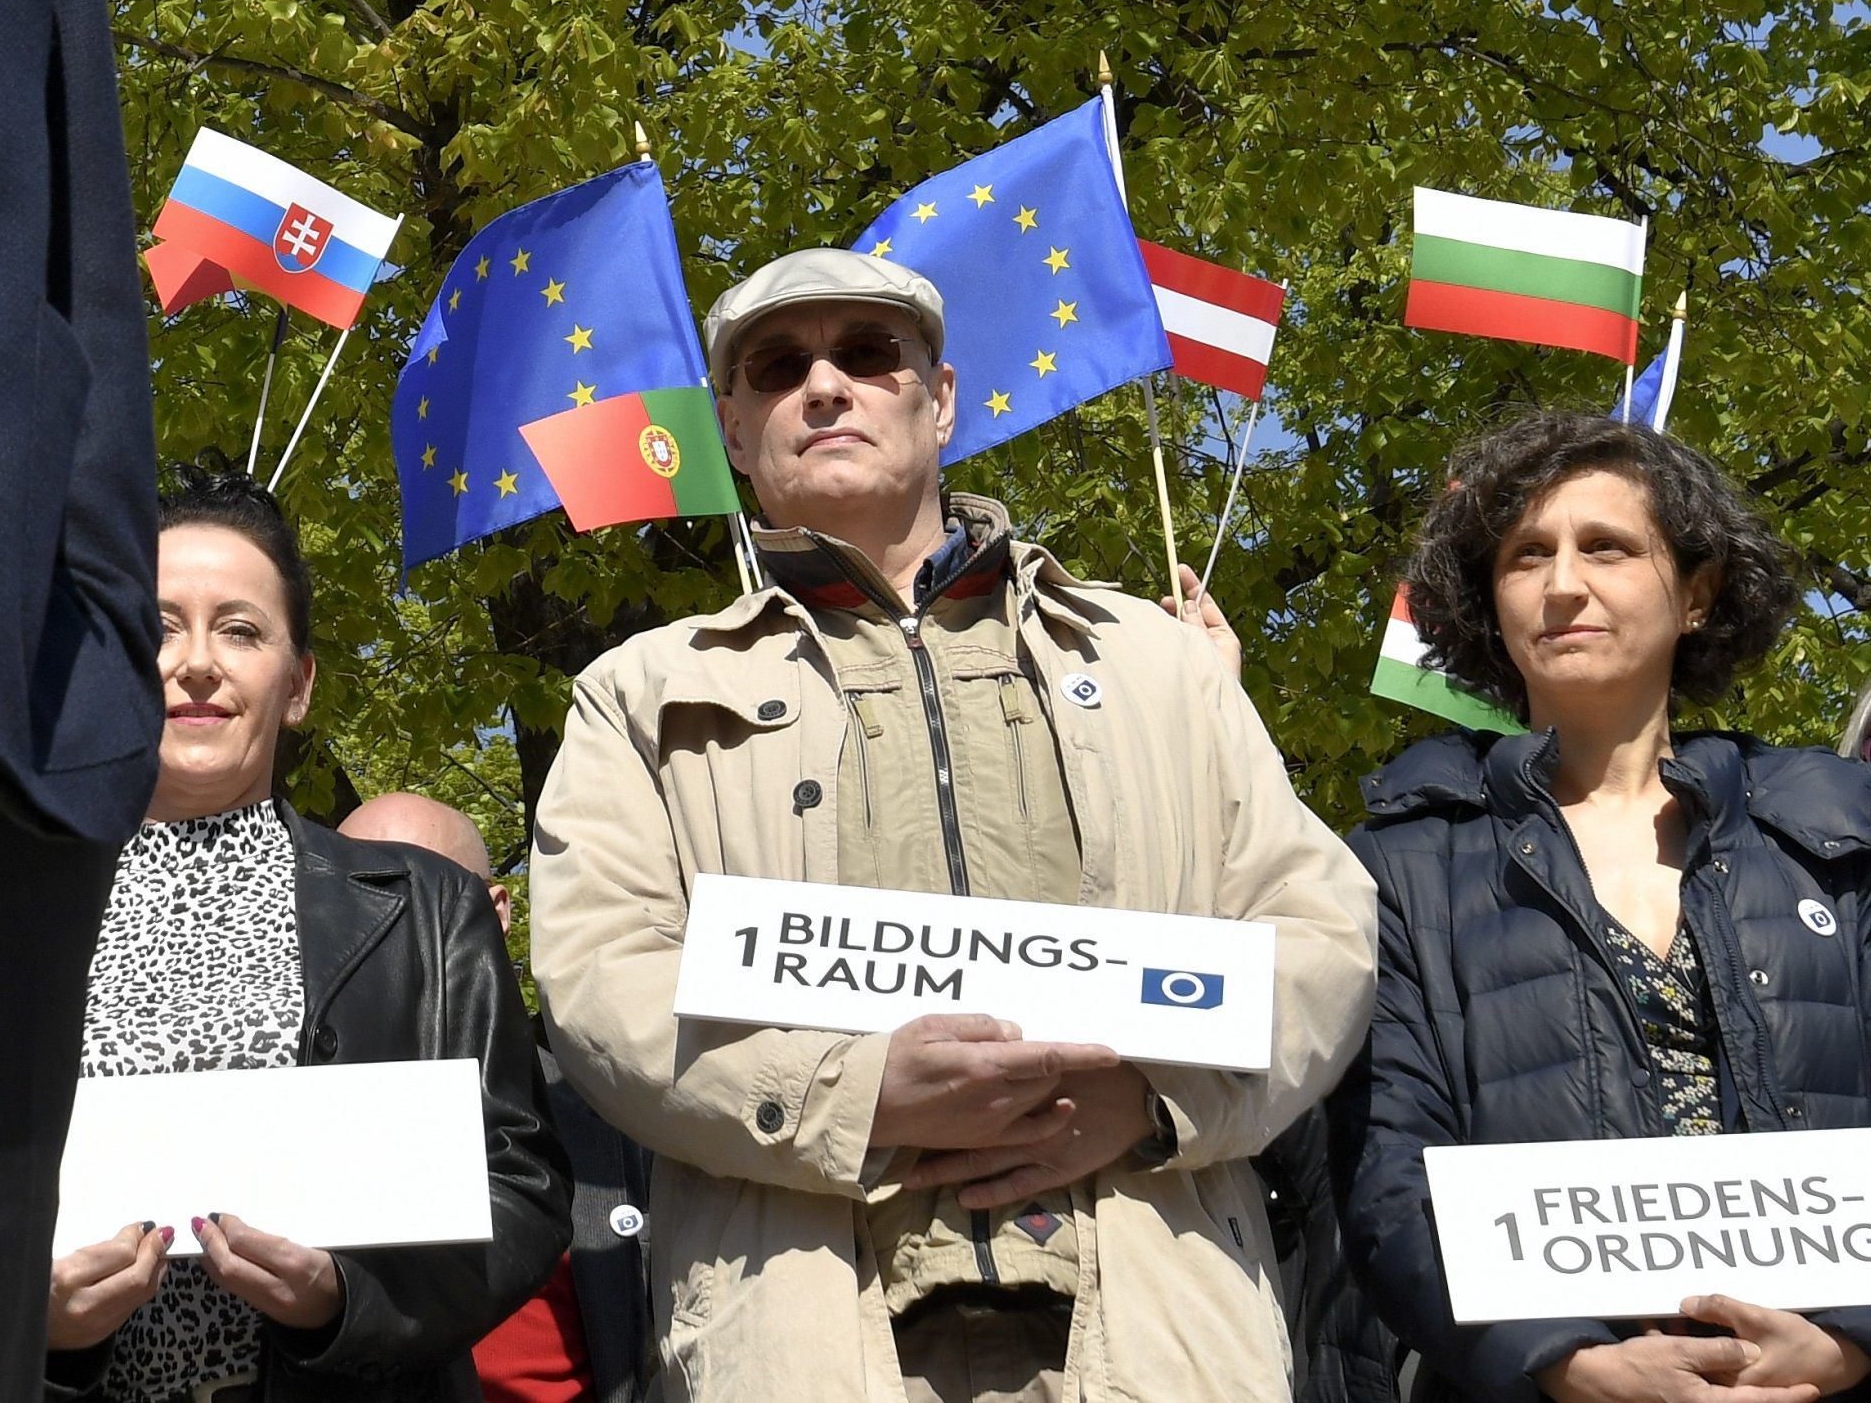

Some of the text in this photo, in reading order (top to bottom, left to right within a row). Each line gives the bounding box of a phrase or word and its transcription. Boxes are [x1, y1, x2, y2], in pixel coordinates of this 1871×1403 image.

[734, 912, 1128, 972] 1 BILDUNGS-
[773, 951, 964, 1001] RAUM
[1494, 1176, 1865, 1261] 1 FRIEDENS-
[1543, 1222, 1871, 1275] ORDNUNG
